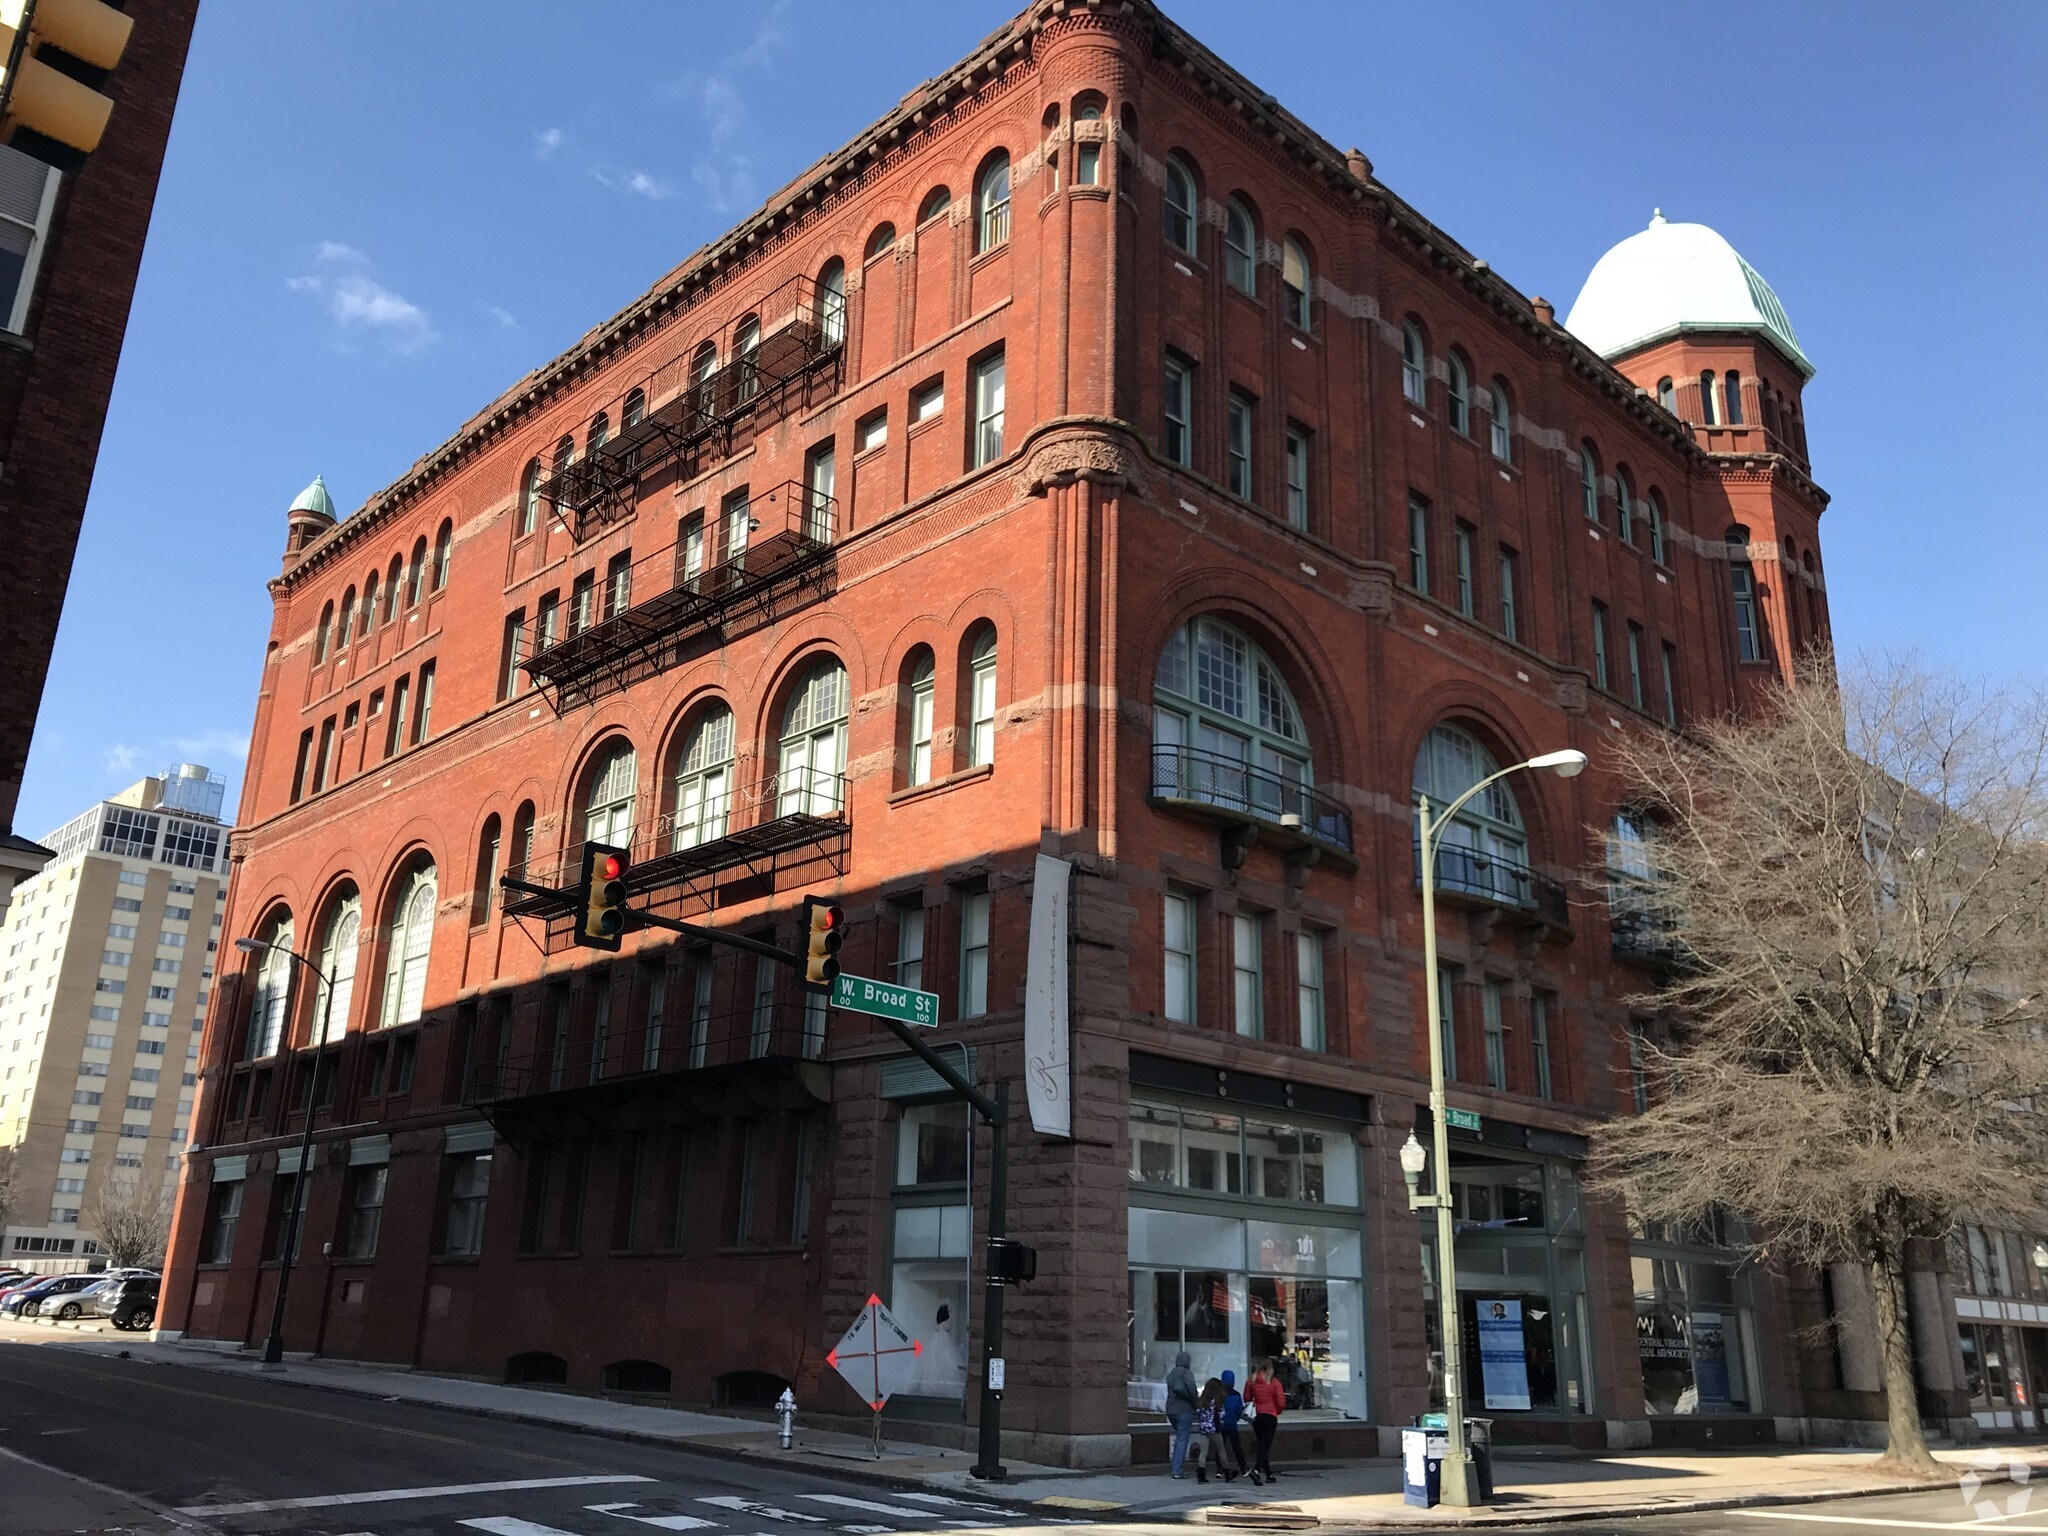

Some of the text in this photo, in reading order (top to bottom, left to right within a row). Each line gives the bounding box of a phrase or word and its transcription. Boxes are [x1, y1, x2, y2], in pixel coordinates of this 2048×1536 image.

[840, 996, 851, 1006] 00
[842, 979, 931, 1013] W. Broad St
[916, 1013, 930, 1023] 100
[1453, 1110, 1472, 1127] Broad
